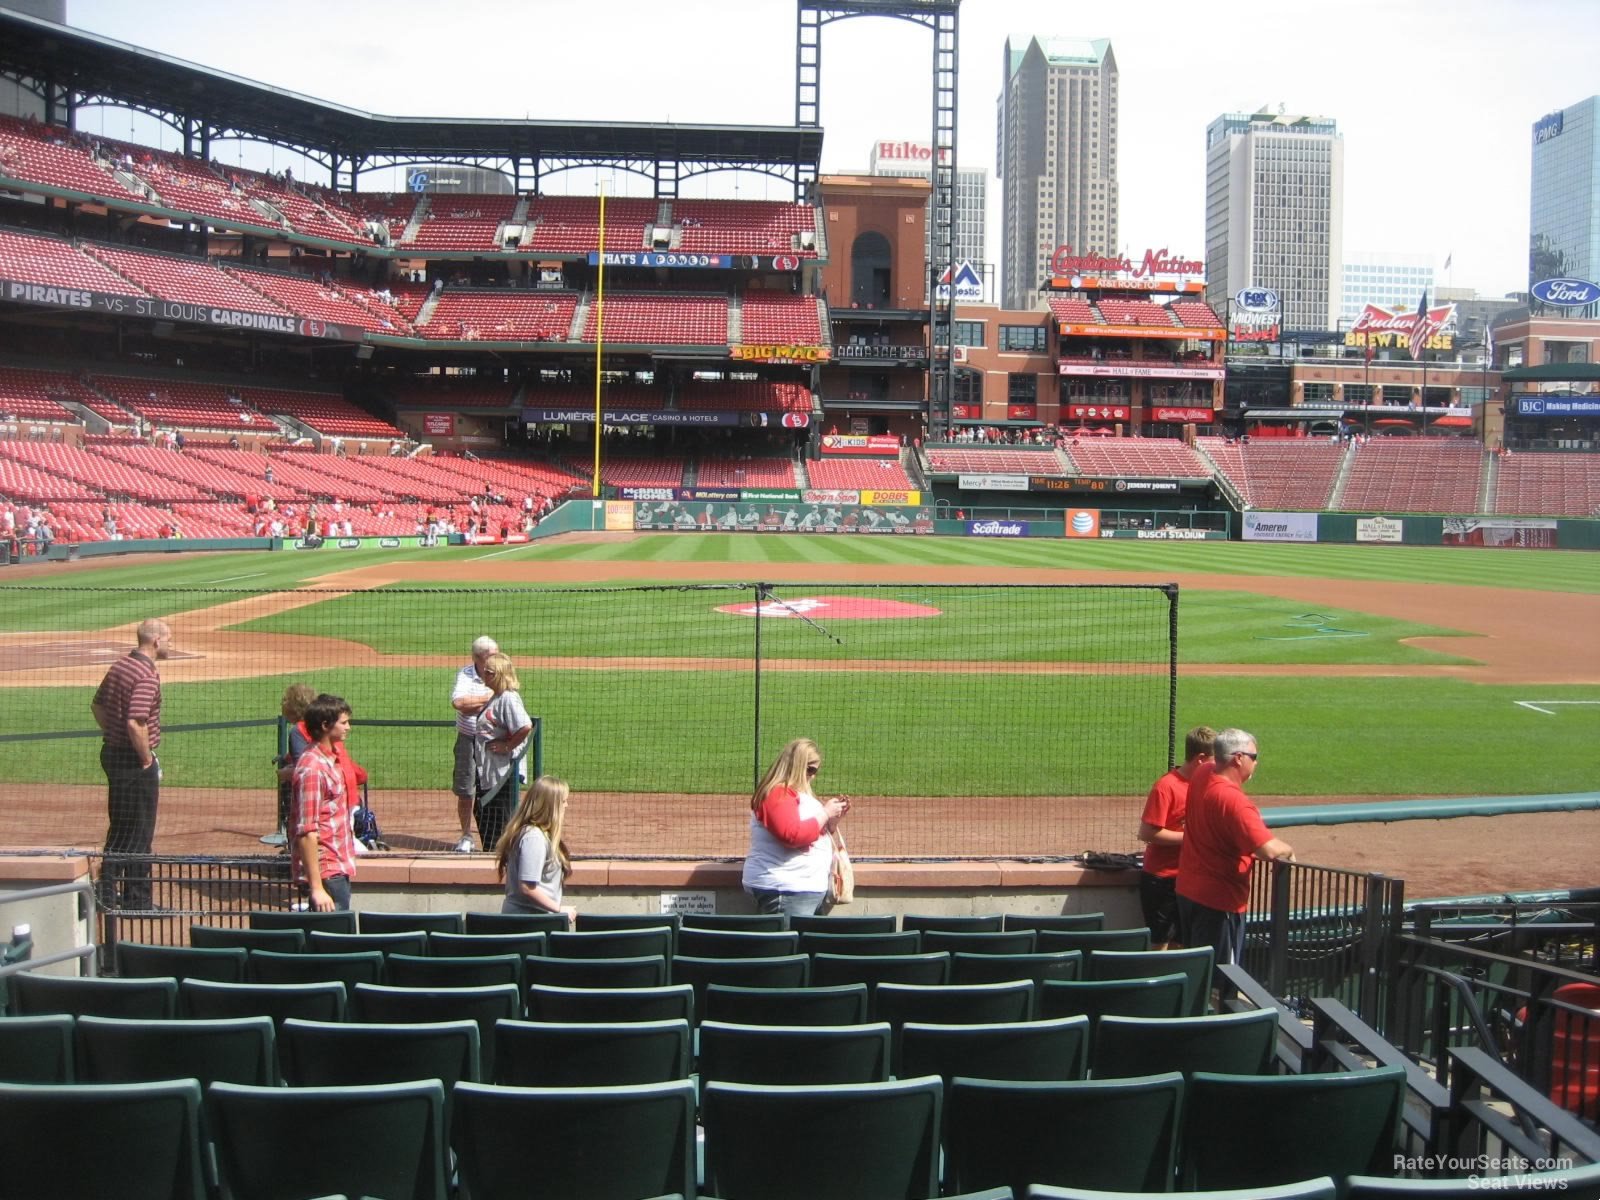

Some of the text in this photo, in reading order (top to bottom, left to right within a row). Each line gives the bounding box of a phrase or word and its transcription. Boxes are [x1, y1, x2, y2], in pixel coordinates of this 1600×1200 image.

[642, 255, 649, 265] A
[655, 254, 709, 266] POWER
[1051, 245, 1204, 278] Cardinals Nation
[1546, 281, 1589, 301] Ford
[1244, 291, 1268, 303] FOX
[11, 283, 92, 307] PIRATES
[135, 300, 157, 316] ST.
[163, 304, 207, 322] LOUIS
[211, 309, 296, 333] CARDINALS
[1230, 312, 1281, 325] MIDWEST
[1345, 332, 1392, 347] BREW
[742, 346, 817, 360] BIG MAC
[1112, 367, 1129, 375] HALL
[1134, 368, 1152, 376] FAME
[1522, 401, 1542, 412] BJC
[1546, 402, 1570, 411] Making
[543, 411, 597, 421] LUMIÈRE
[604, 413, 649, 422] PLACE
[652, 414, 681, 422] CASINO
[847, 438, 866, 446] KIDS
[962, 479, 982, 488] Mercy
[1127, 482, 1177, 491] JIMMY JOHN'S
[873, 491, 909, 500] DOBBS
[972, 521, 1023, 536] Scottrade
[1255, 522, 1288, 532] Ameren
[1137, 530, 1206, 539] BUSCH STADIUM
[696, 902, 714, 910] objects
